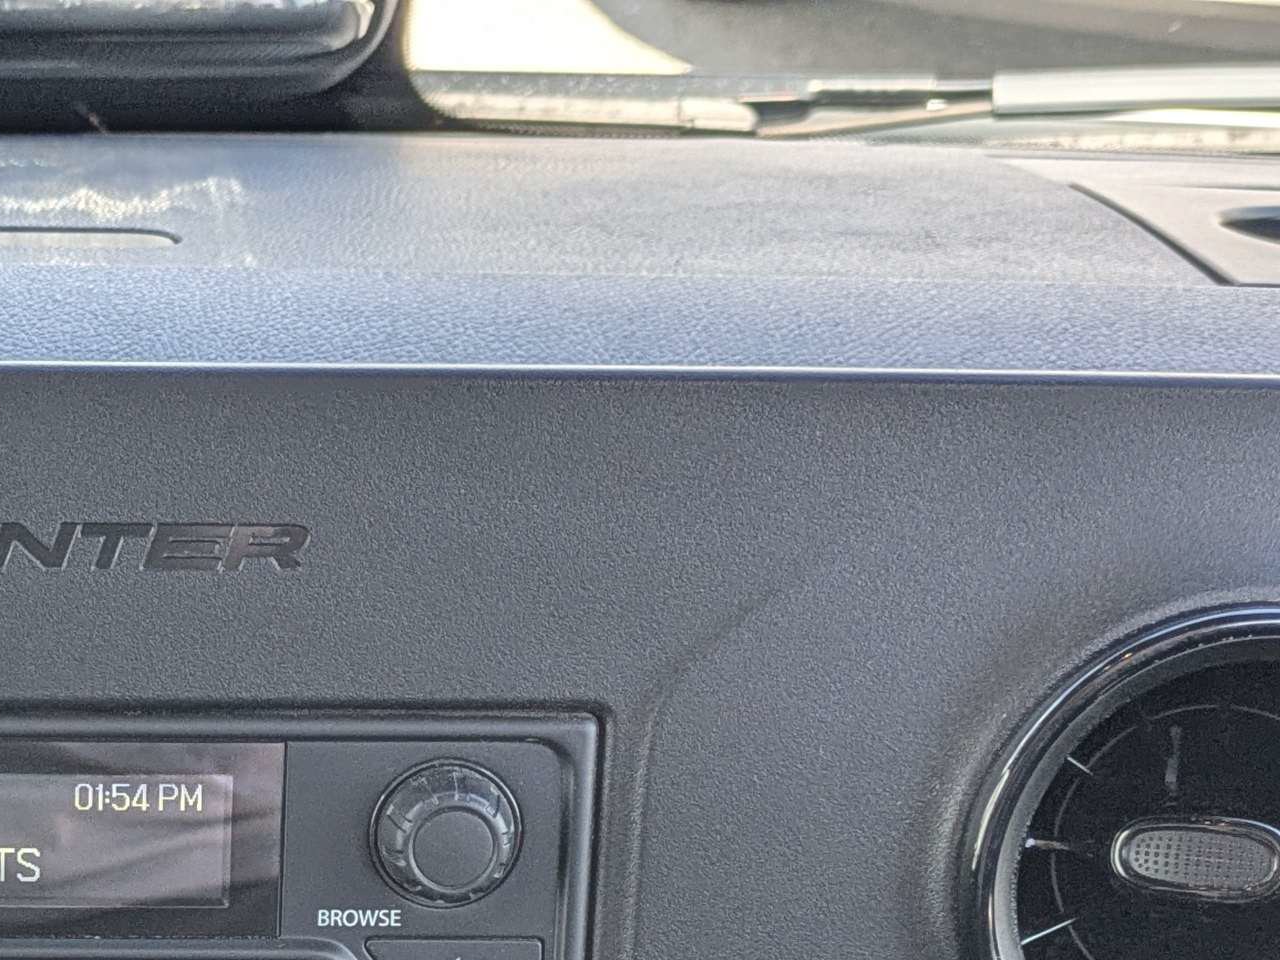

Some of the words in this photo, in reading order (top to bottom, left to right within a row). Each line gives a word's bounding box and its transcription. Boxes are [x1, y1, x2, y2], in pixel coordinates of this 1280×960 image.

[75, 783, 148, 811] 01:54
[158, 783, 202, 811] PM
[317, 909, 401, 927] BROWSE
